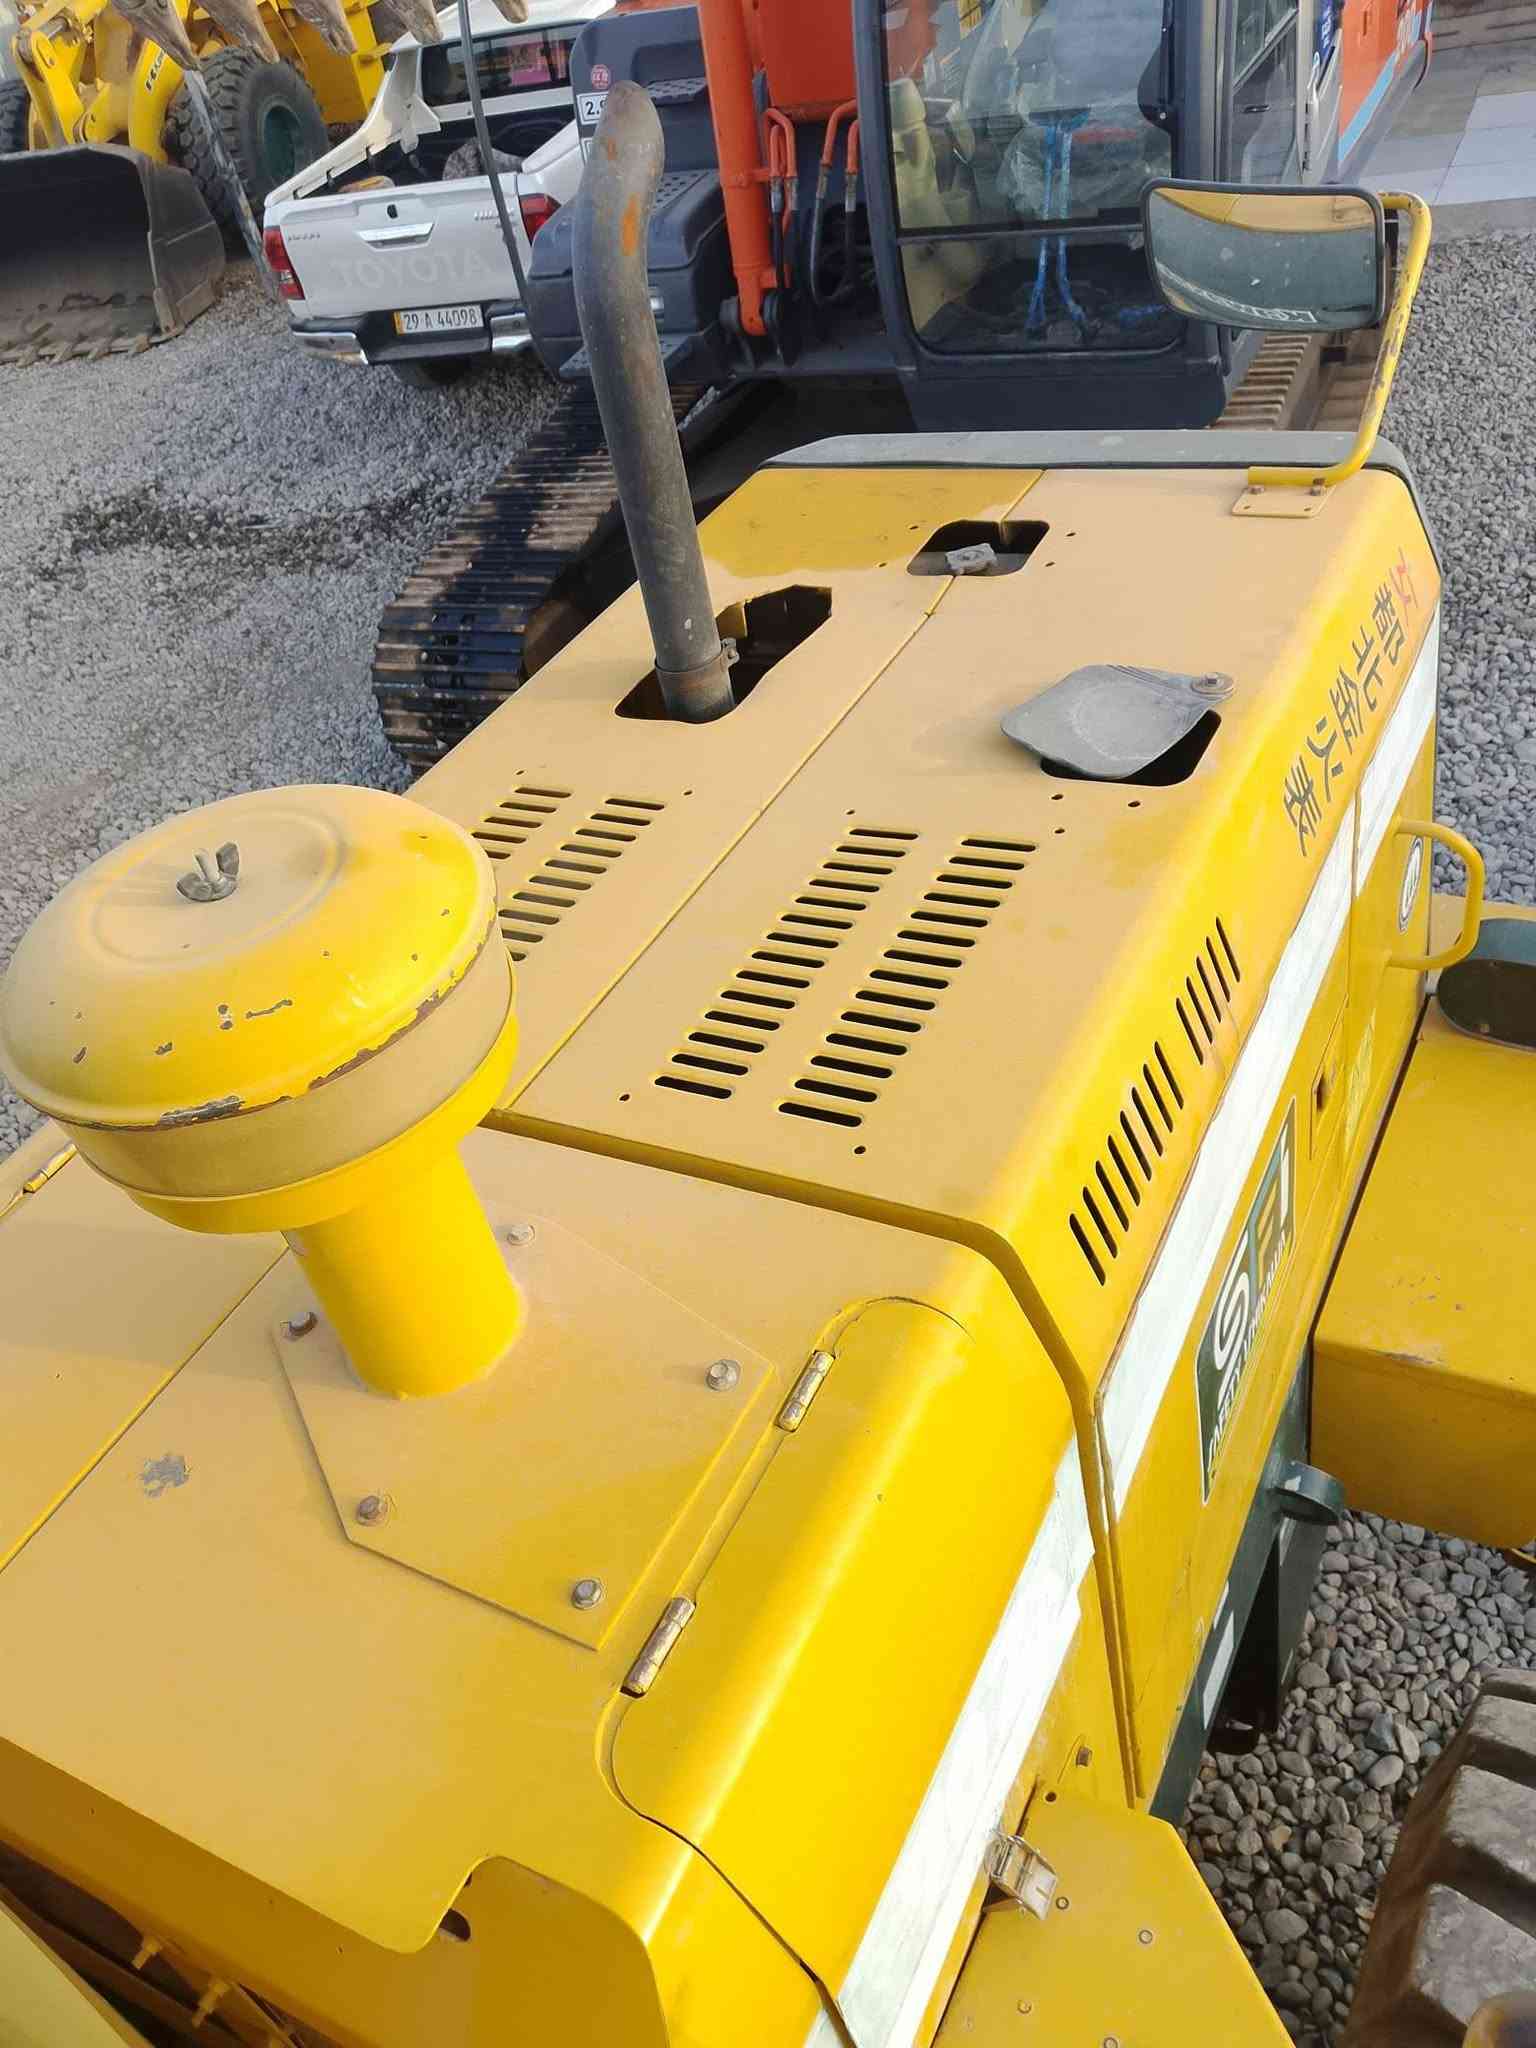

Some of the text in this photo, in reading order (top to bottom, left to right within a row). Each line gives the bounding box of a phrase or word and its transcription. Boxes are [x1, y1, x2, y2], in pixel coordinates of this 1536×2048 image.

[334, 249, 493, 289] TOYOTA
[404, 313, 419, 330] 29
[437, 308, 478, 328] 44098
